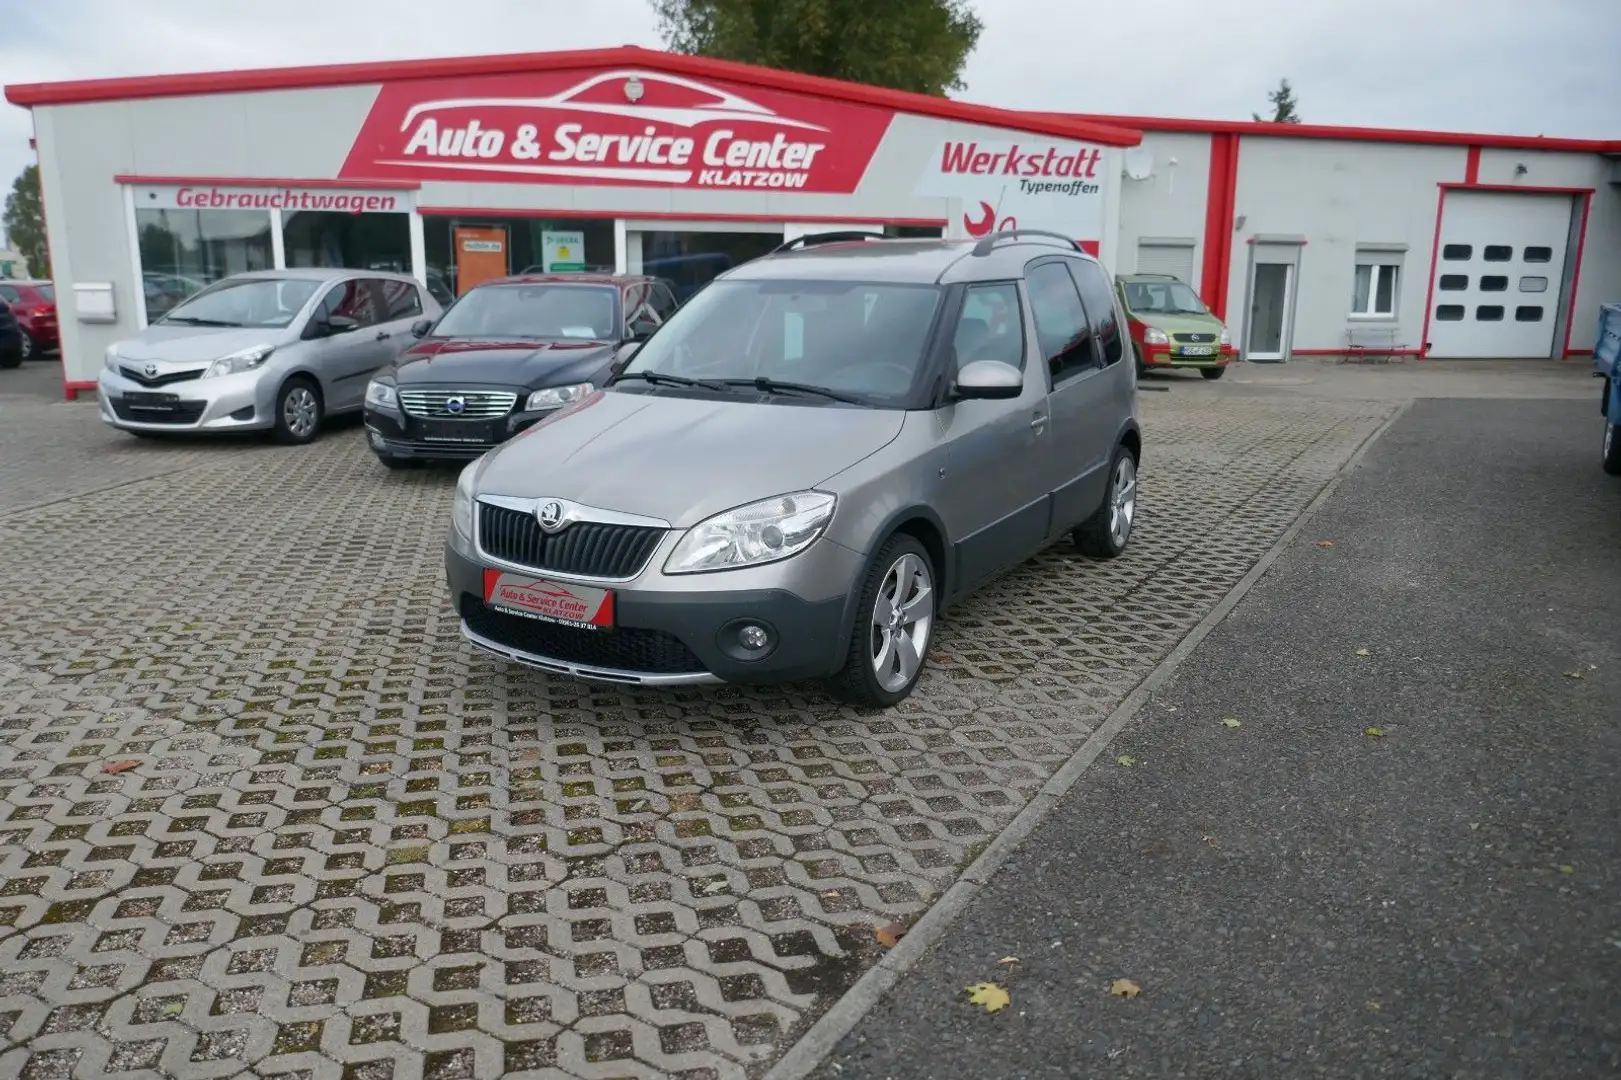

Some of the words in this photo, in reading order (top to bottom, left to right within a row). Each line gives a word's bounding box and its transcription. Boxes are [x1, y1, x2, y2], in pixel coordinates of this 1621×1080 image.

[404, 118, 504, 159] Auto
[511, 123, 540, 160] &
[548, 123, 692, 165] Service
[703, 130, 826, 170] Center
[941, 142, 1101, 178] Werkstatt
[698, 168, 809, 187] KLATZOW
[1020, 179, 1099, 195] Typenoffen
[176, 187, 396, 215] Gebrauchtwagen
[500, 588, 517, 600] Auto
[527, 593, 557, 607] Service
[559, 599, 588, 613] Center
[508, 608, 523, 617] Service
[543, 607, 584, 620] KLATZOW
